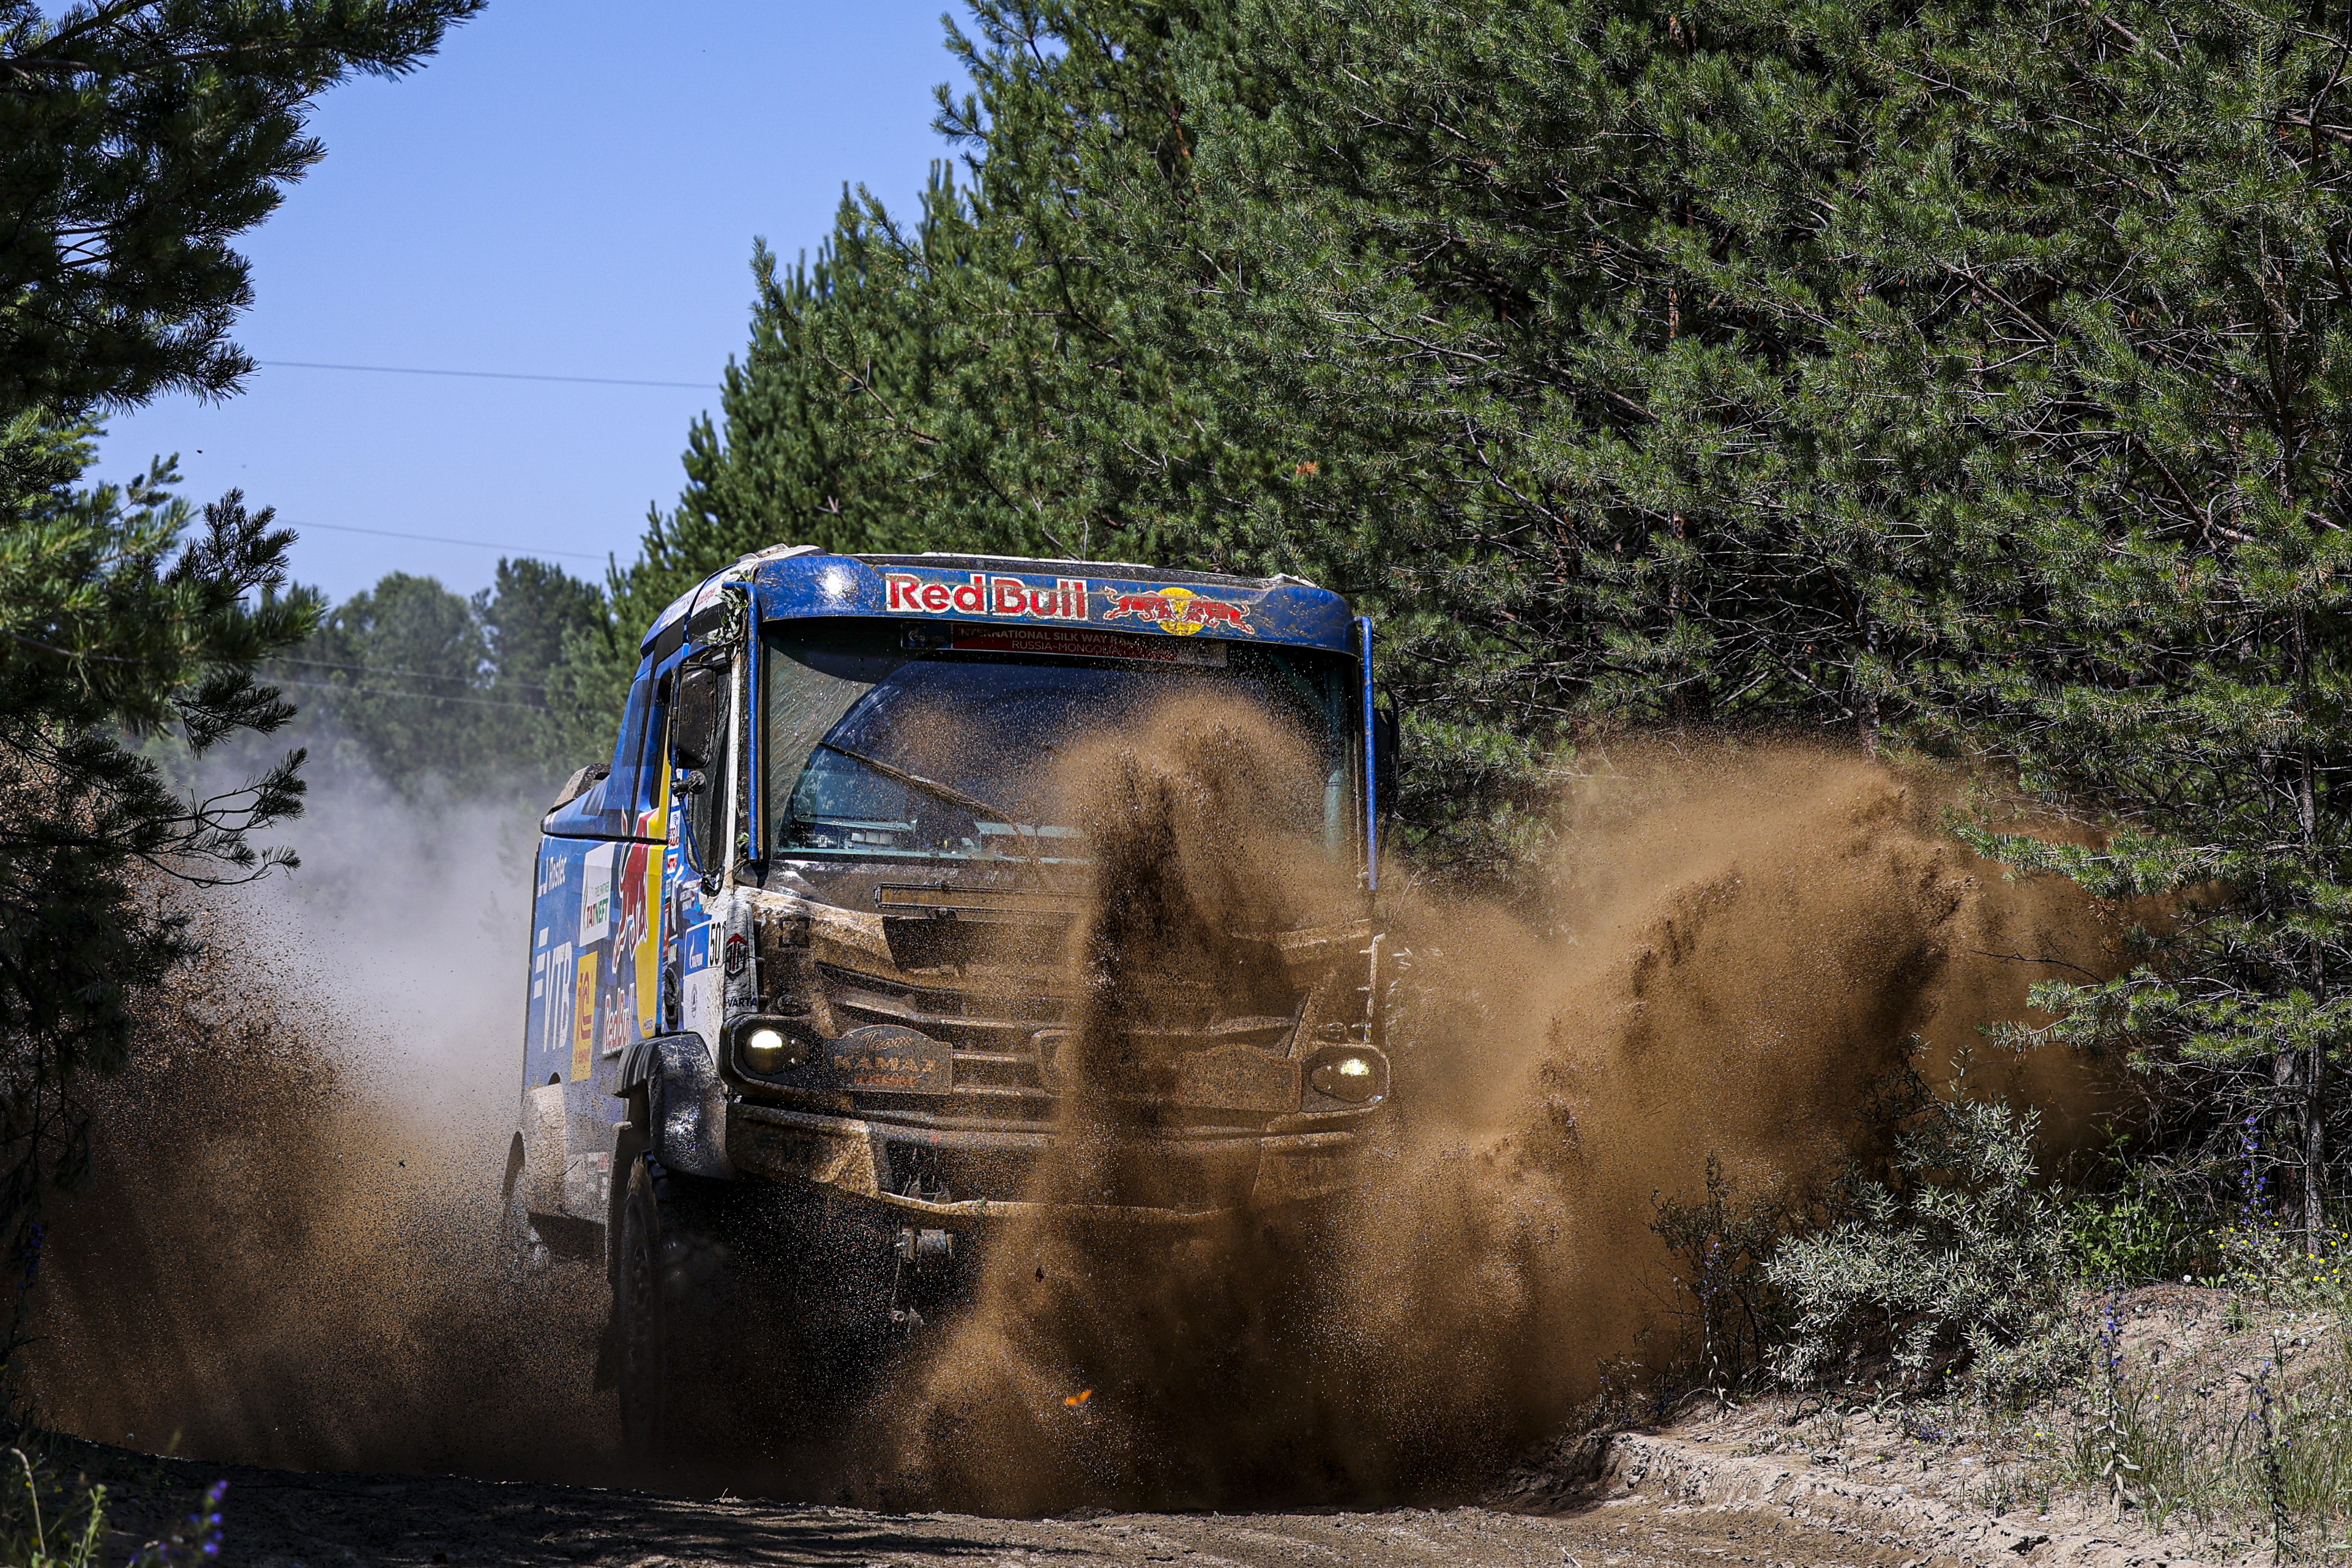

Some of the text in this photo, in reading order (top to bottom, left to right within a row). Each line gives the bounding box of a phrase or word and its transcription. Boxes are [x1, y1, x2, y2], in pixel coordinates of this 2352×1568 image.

[886, 573, 1088, 621] Red Bull
[958, 628, 1051, 641] INTERNATIONAL
[1053, 632, 1078, 642] SILK
[1082, 633, 1107, 643] WAY
[548, 854, 567, 891] Rostec
[586, 897, 610, 929] TATNEFT
[543, 941, 573, 1053] VTB
[727, 998, 757, 1008] VARTA
[602, 982, 635, 1055] Red Bull
